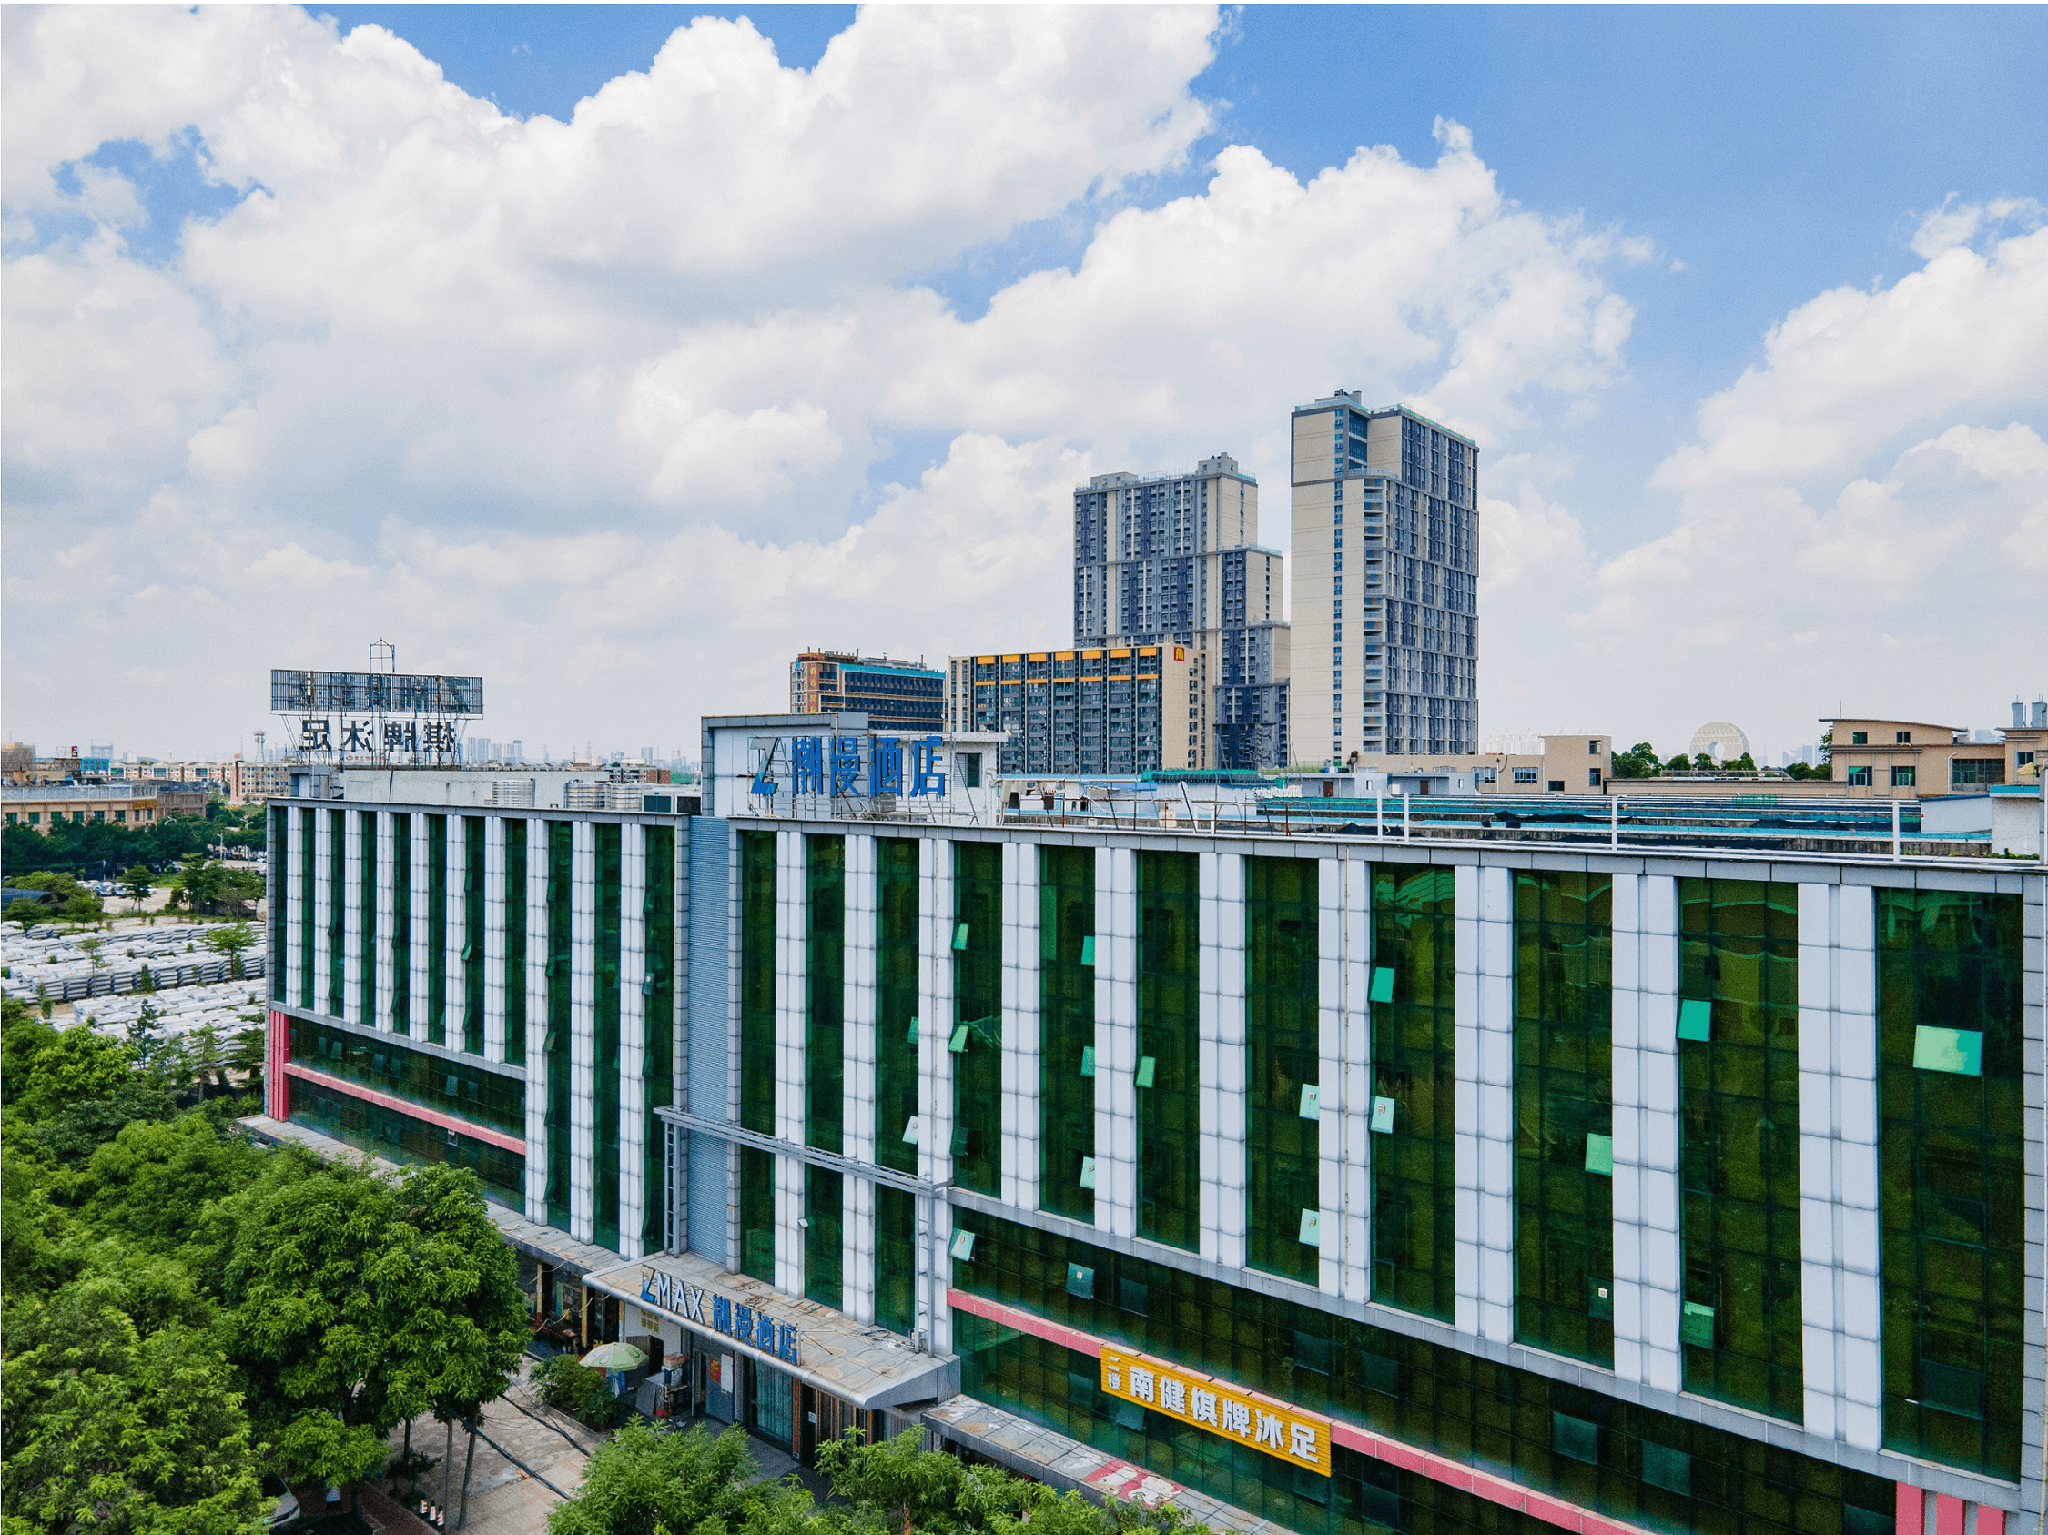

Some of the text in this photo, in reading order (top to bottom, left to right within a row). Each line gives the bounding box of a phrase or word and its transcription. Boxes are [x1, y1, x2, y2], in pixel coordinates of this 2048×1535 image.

[792, 735, 946, 798] 潮漫酒店
[640, 1265, 797, 1365] ZMAX 潮漫酒店
[1129, 1365, 1319, 1464] 南健棋牌沐足
